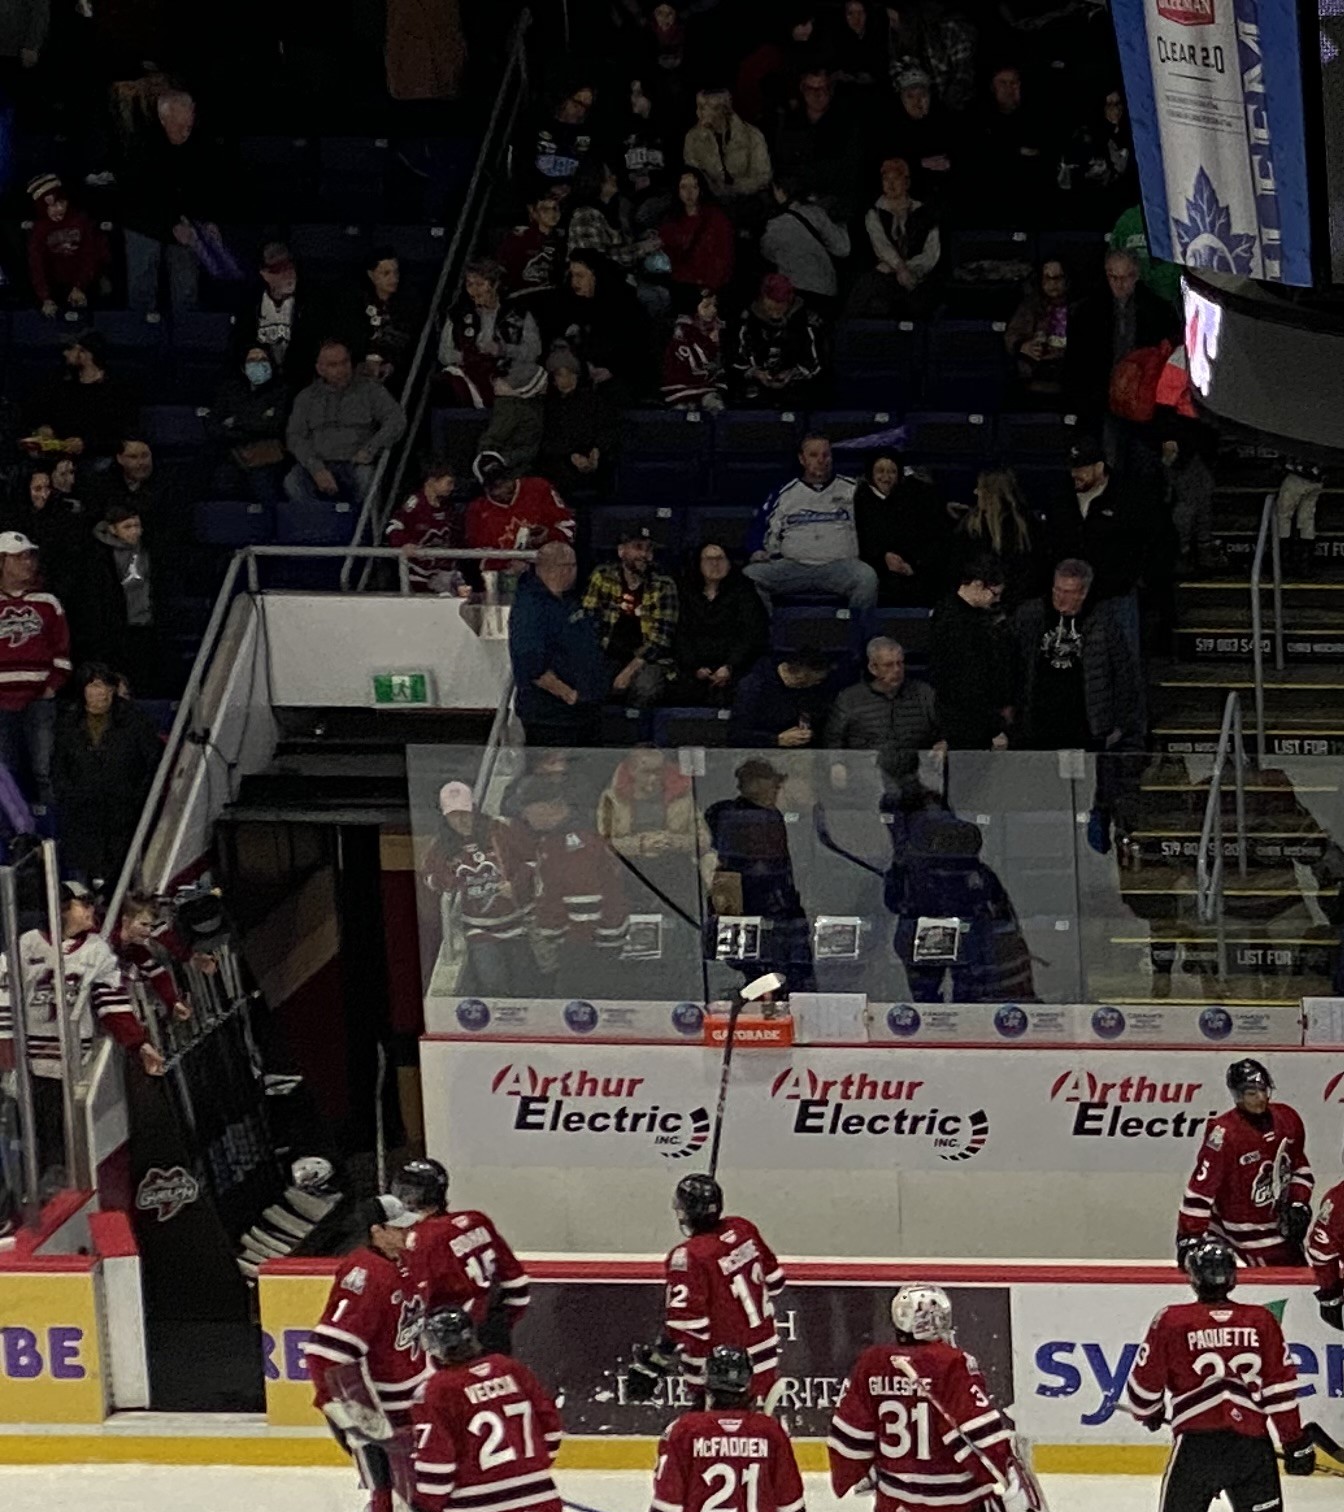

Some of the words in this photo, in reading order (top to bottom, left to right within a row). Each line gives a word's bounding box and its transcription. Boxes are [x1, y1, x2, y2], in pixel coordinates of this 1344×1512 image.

[1157, 36, 1198, 67] CLEAR
[1201, 45, 1225, 73] 2.0
[1302, 738, 1329, 755] FOR
[491, 1063, 645, 1098] Arthur
[771, 1066, 923, 1101] Arthur
[1051, 1070, 1202, 1103] Arthur
[514, 1095, 683, 1131] Electric
[794, 1097, 962, 1137] Electric
[1072, 1101, 1218, 1138] Electri
[654, 1134, 682, 1146] INC.
[933, 1137, 960, 1149] INC.
[1314, 1229, 1330, 1245] 3
[331, 1298, 349, 1323] 1
[1187, 1326, 1260, 1351] PAQUETTE
[868, 1376, 933, 1397] GILLESPE
[1191, 1350, 1263, 1401] 23
[468, 1401, 540, 1472] 27
[877, 1400, 931, 1460] 31
[692, 1437, 770, 1458] McFADDEN
